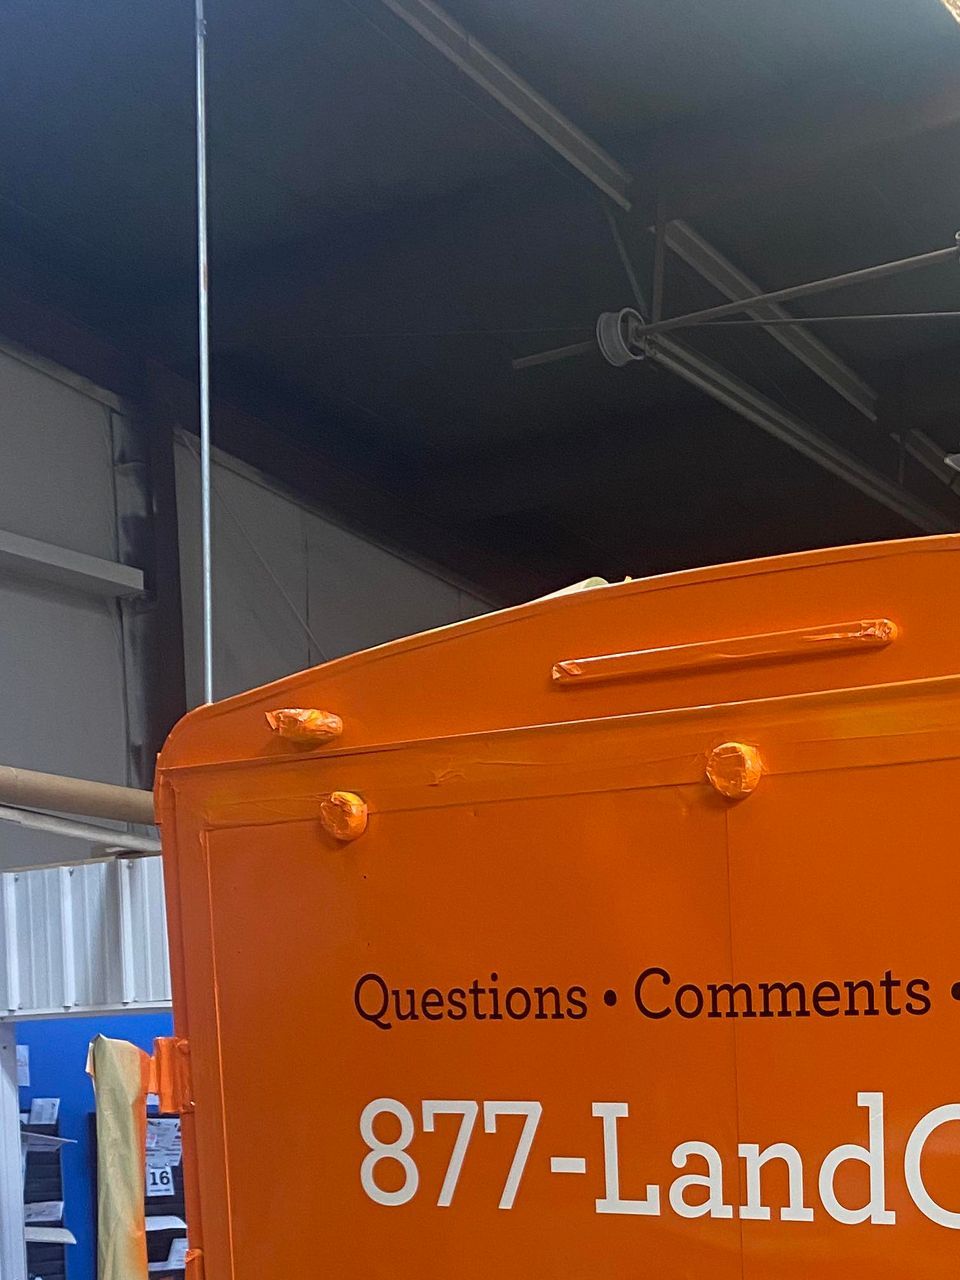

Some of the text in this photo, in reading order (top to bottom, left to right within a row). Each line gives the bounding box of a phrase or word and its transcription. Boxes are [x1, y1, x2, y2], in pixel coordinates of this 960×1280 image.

[353, 972, 588, 1031] Questions
[634, 967, 932, 1020] Comments
[150, 1171, 170, 1186] 16
